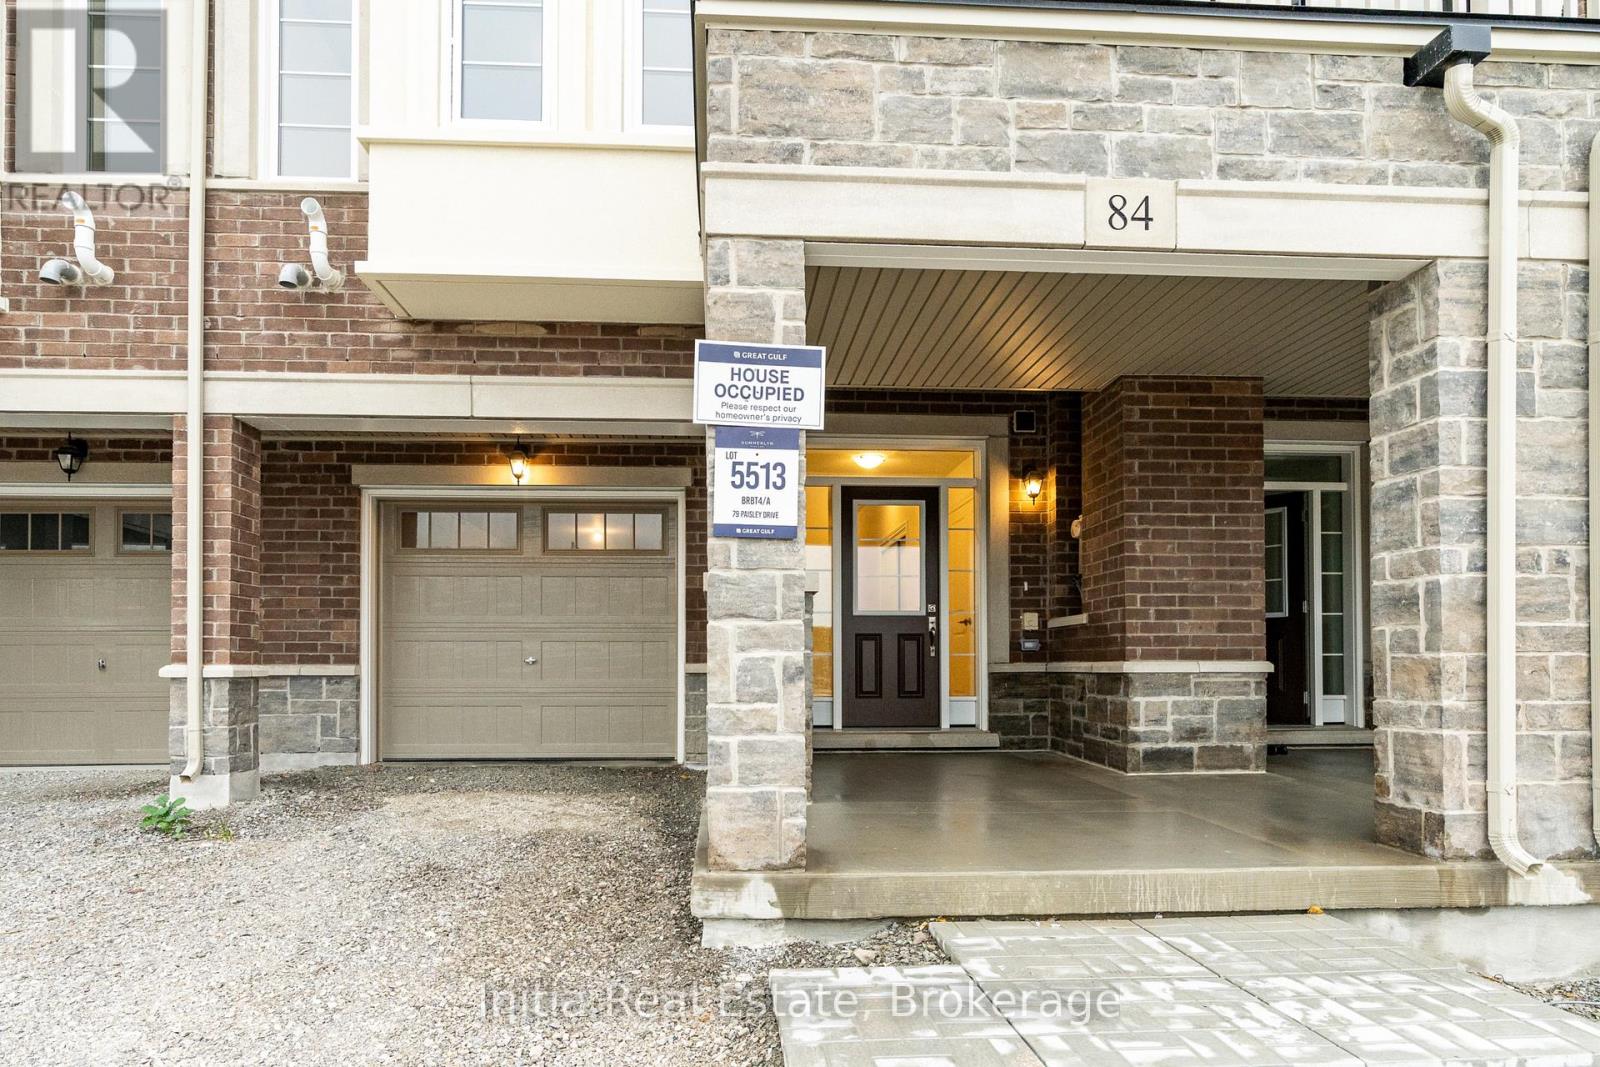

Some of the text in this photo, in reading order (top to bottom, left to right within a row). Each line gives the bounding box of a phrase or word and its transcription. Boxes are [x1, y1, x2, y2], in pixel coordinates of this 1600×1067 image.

[1108, 194, 1154, 231] 84
[741, 351, 788, 361] GREAT GULF
[730, 367, 790, 384] HOUSE
[714, 383, 805, 402] OCCUPIED
[720, 401, 748, 411] Please
[750, 403, 781, 415] respect
[715, 411, 802, 424] homeowner's privacy
[725, 451, 738, 460] LOT
[730, 461, 786, 490] 5513
[732, 510, 779, 519] 79 PAISLEY DRIVE
